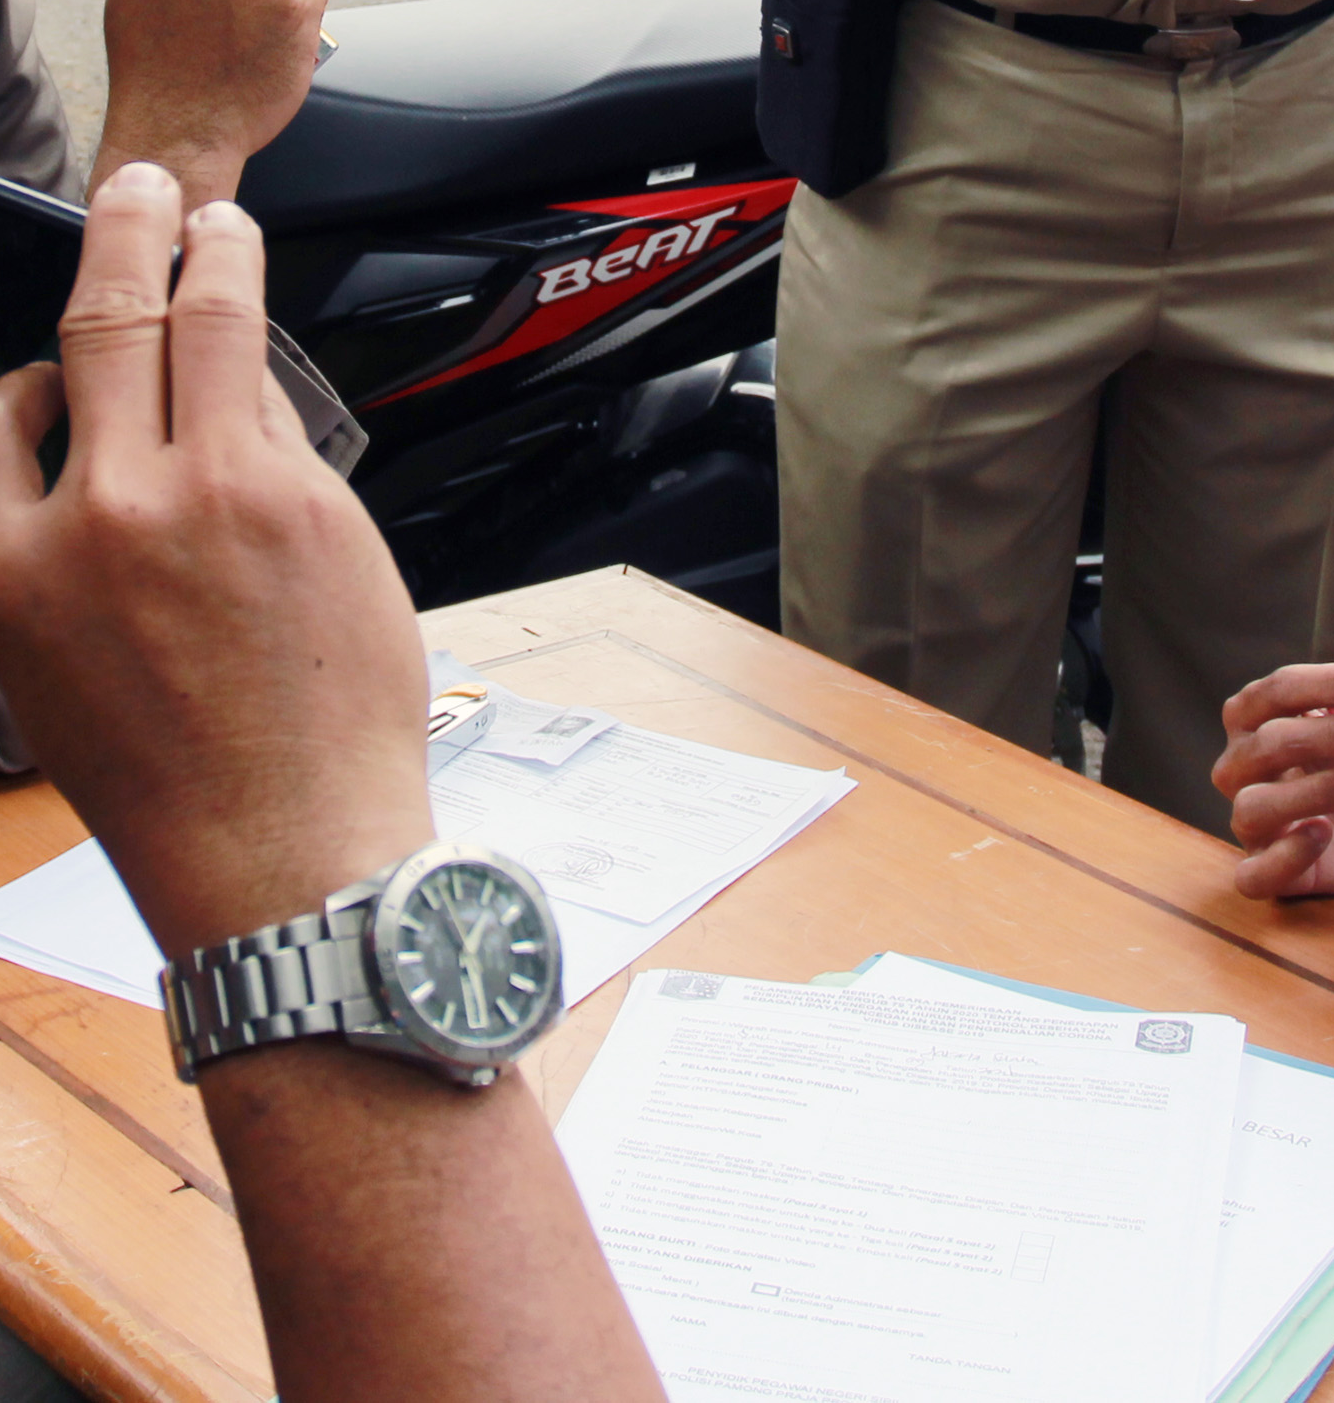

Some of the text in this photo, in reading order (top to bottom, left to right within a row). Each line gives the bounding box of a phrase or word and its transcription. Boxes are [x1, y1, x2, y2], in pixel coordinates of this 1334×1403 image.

[1241, 1119, 1313, 1149] BESAR
[1222, 1197, 1257, 1213] ahun
[600, 1239, 753, 1273] ANKSI YANG DIBERIKAN
[602, 1225, 657, 1243] BARANG
[658, 1233, 697, 1248] BUKTI
[784, 1256, 817, 1270] Video
[670, 1313, 708, 1328] NAMA
[907, 1352, 1012, 1375] TANDA TANGAN
[669, 1371, 712, 1386] POLISI
[713, 1378, 773, 1397] PAMONG
[687, 1366, 750, 1385] PENYIDIK
[751, 1374, 814, 1394] PEGAWAI
